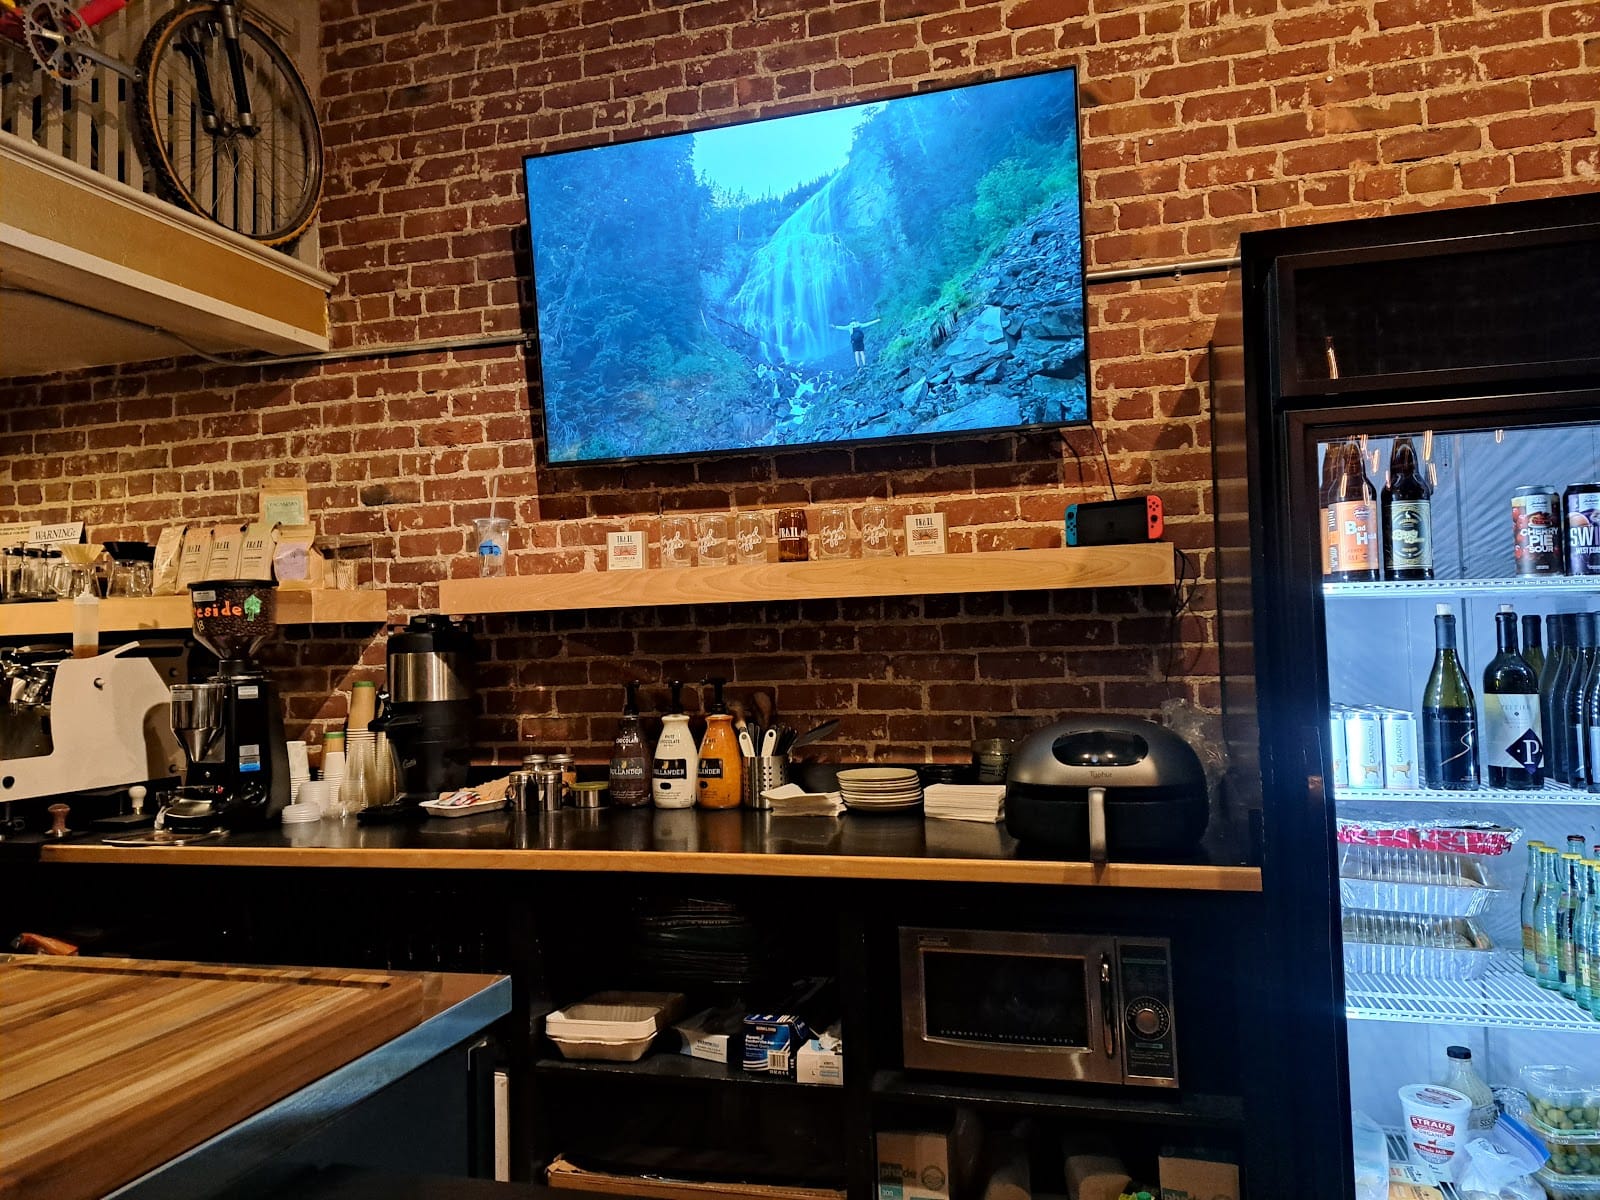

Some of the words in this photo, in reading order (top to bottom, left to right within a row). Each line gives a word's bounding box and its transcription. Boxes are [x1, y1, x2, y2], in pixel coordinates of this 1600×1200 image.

[35, 527, 76, 540] WARNING:
[1520, 527, 1558, 536] CHERRY
[1570, 526, 1600, 546] SWI
[1529, 535, 1554, 546] PIE
[1523, 739, 1540, 765] P
[1411, 1116, 1453, 1131] STRAUS
